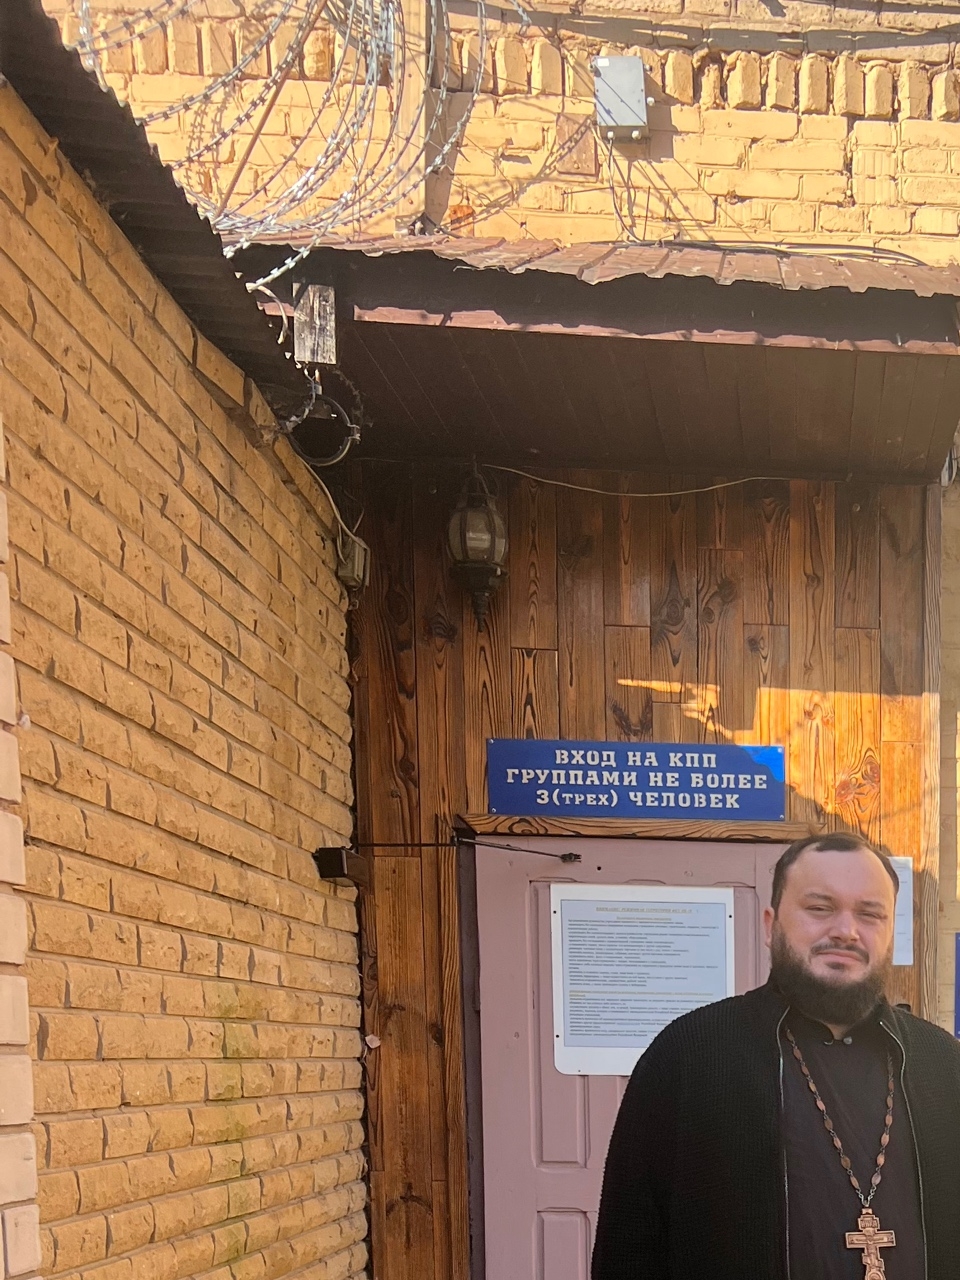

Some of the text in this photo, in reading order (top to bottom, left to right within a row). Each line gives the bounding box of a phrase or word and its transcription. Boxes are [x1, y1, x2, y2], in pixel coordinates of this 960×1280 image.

[555, 749, 717, 768] ВХОД НА КПП
[506, 768, 768, 789] ГРУППАМИ НЕ БОЛЕЕ
[628, 791, 740, 809] ЧЕЛОВЕК
